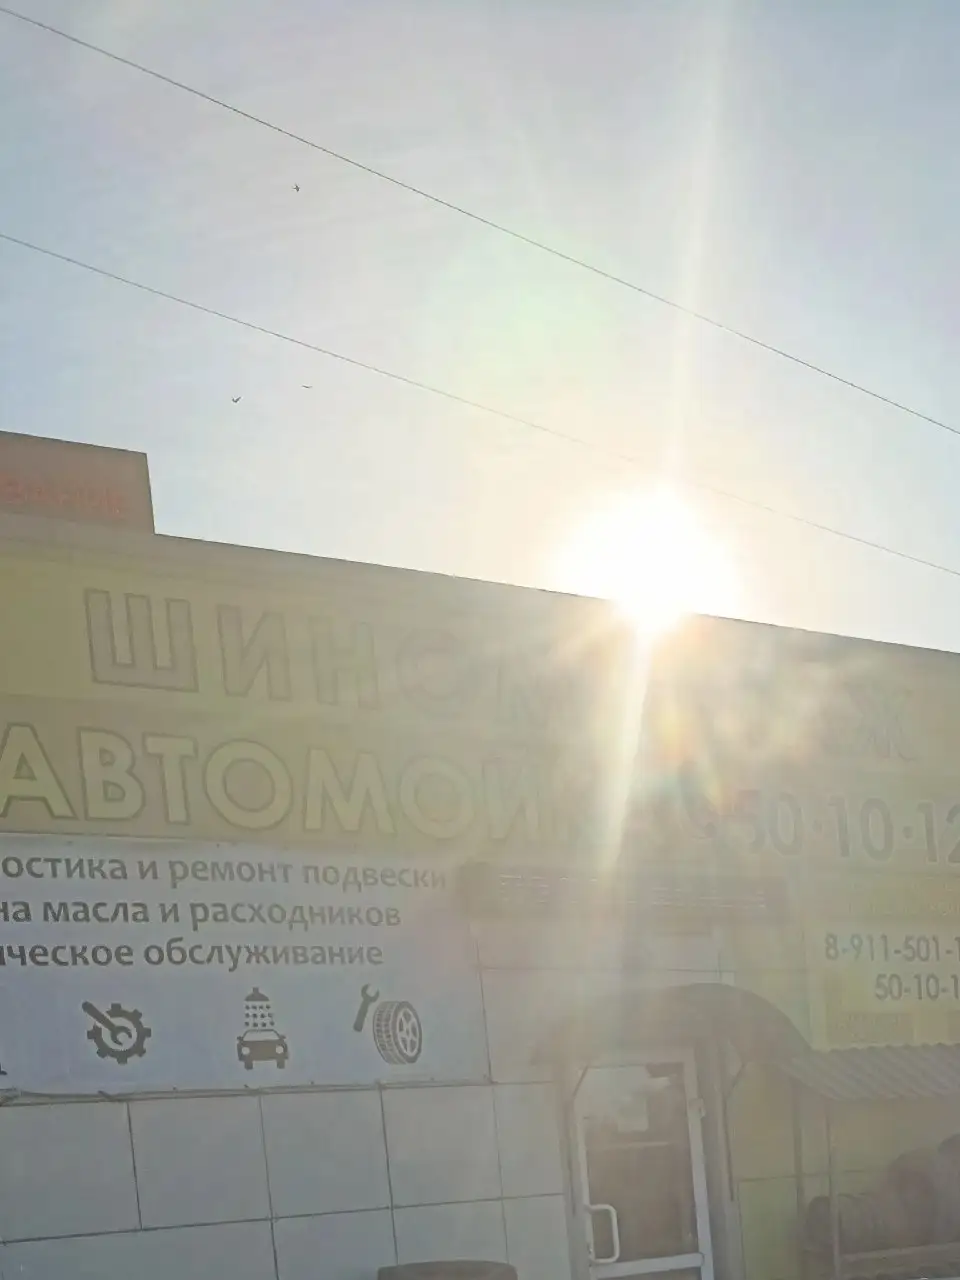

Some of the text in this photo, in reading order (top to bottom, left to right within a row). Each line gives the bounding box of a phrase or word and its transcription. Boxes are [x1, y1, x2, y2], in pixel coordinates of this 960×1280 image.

[138, 857, 159, 880] и
[169, 858, 292, 888] ремонт
[302, 862, 446, 891] подвески
[43, 901, 150, 924] масла
[159, 902, 179, 923] и
[190, 901, 400, 930] расходников
[143, 937, 384, 971] обслуживание
